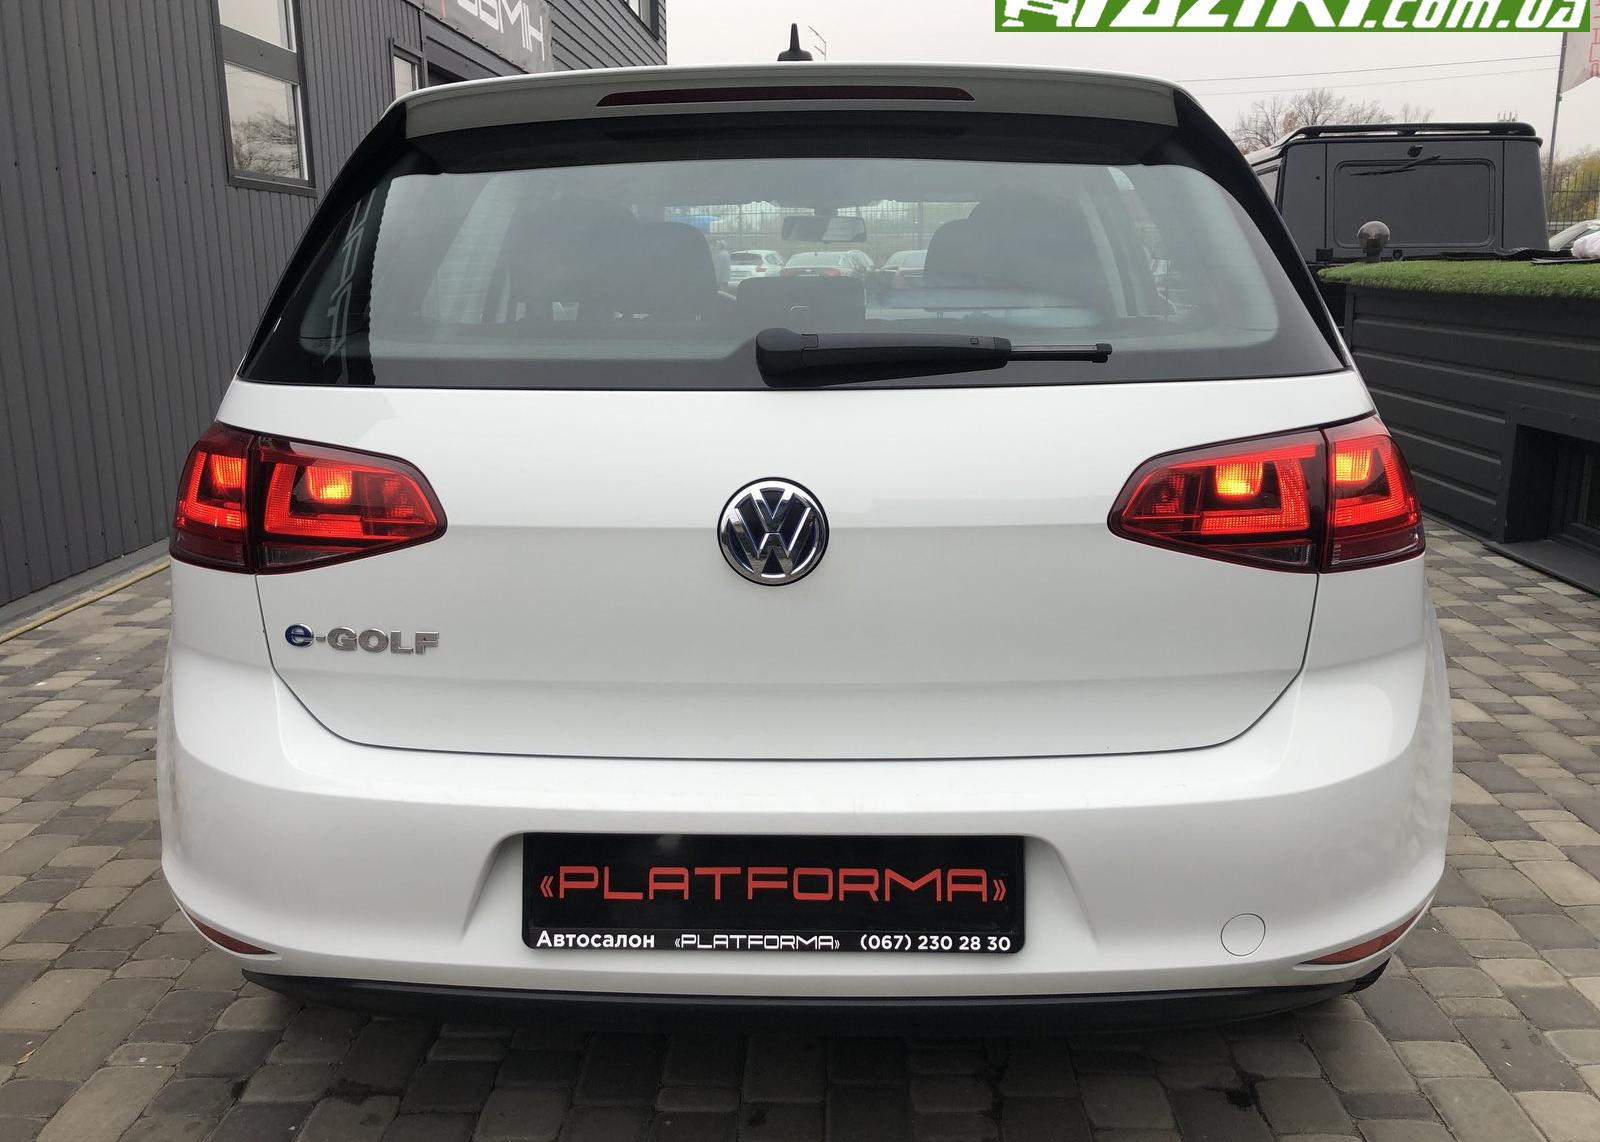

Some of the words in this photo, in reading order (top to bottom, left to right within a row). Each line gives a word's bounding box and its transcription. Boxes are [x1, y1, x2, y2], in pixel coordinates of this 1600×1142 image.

[285, 624, 439, 654] e-GOLF
[536, 930, 655, 949] Автосалон
[860, 934, 912, 951] (067)
[917, 935, 952, 951] 230
[958, 936, 981, 951] 28
[987, 936, 1011, 951] 30
